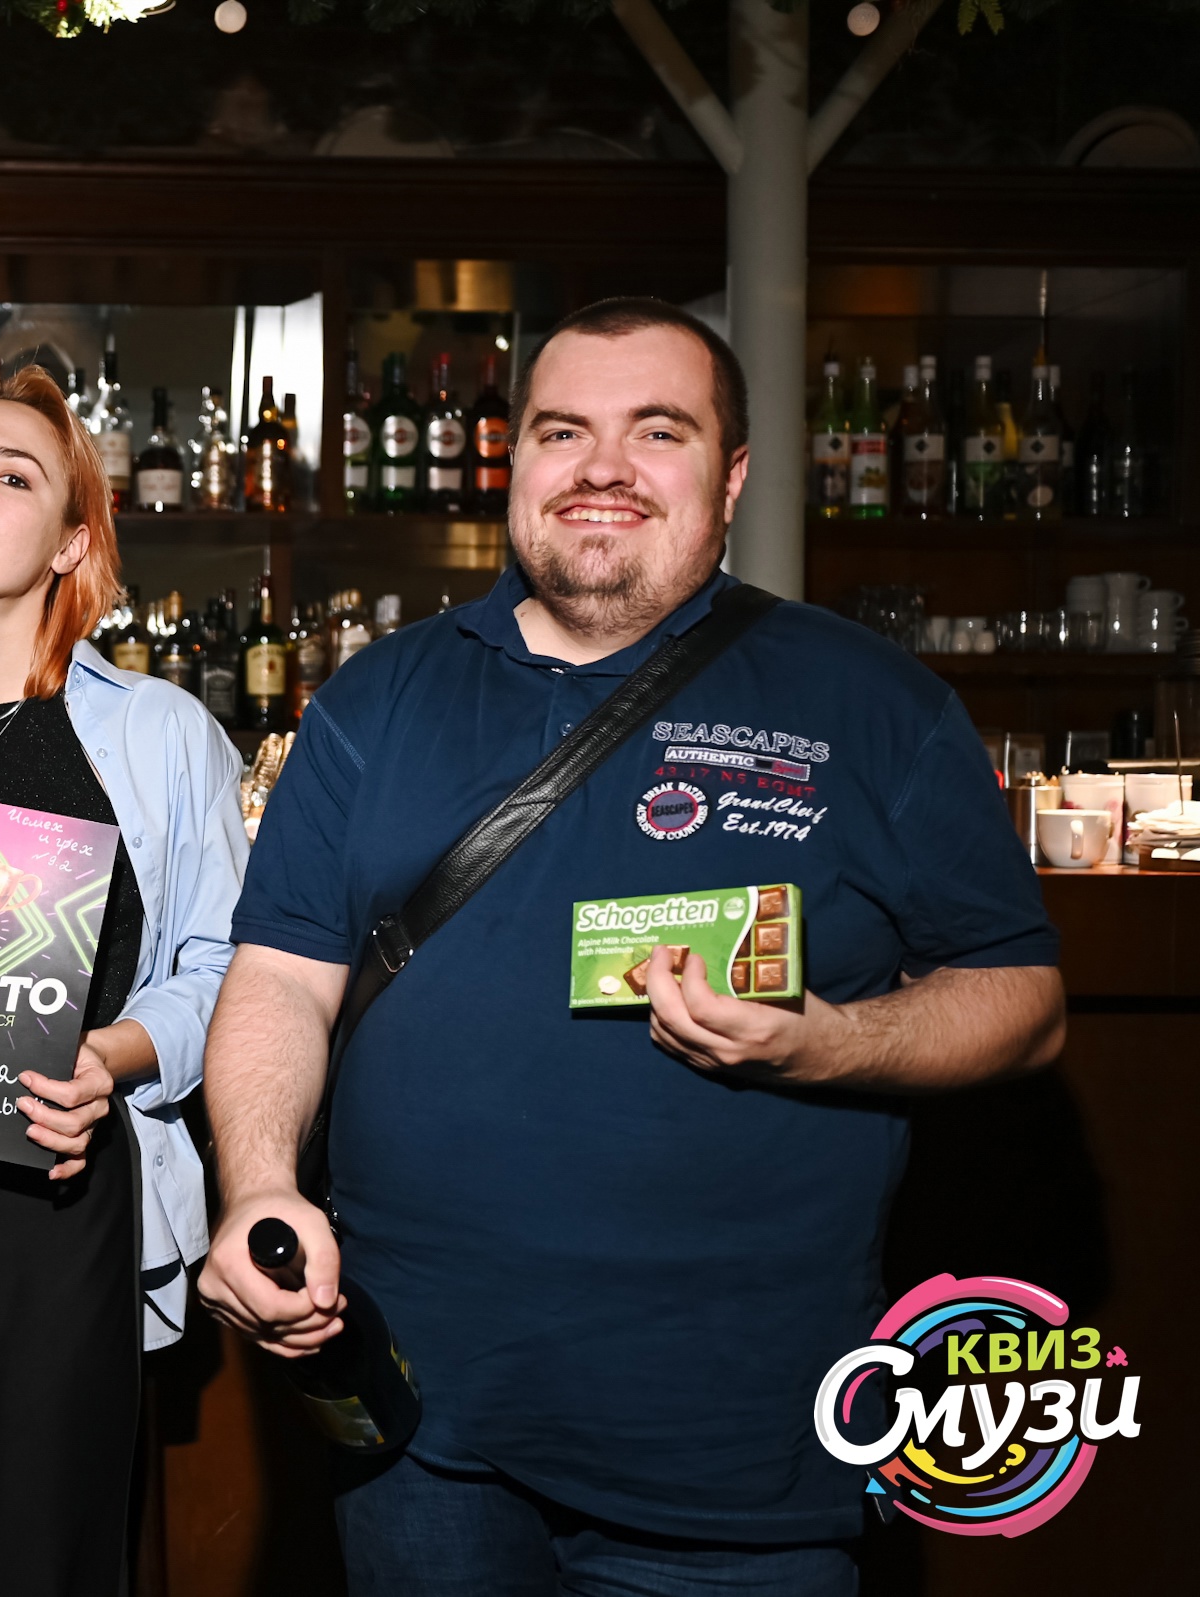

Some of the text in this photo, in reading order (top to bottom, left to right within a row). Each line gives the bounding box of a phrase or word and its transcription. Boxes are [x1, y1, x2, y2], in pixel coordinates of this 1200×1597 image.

[652, 721, 830, 763] SEASCAPES
[667, 749, 755, 767] AUTHENTIC
[642, 782, 673, 802] BREAK
[576, 897, 719, 934] Schogetten
[578, 935, 660, 948] Alpine Milk Chocolate
[578, 946, 634, 957] with Hazelnuts
